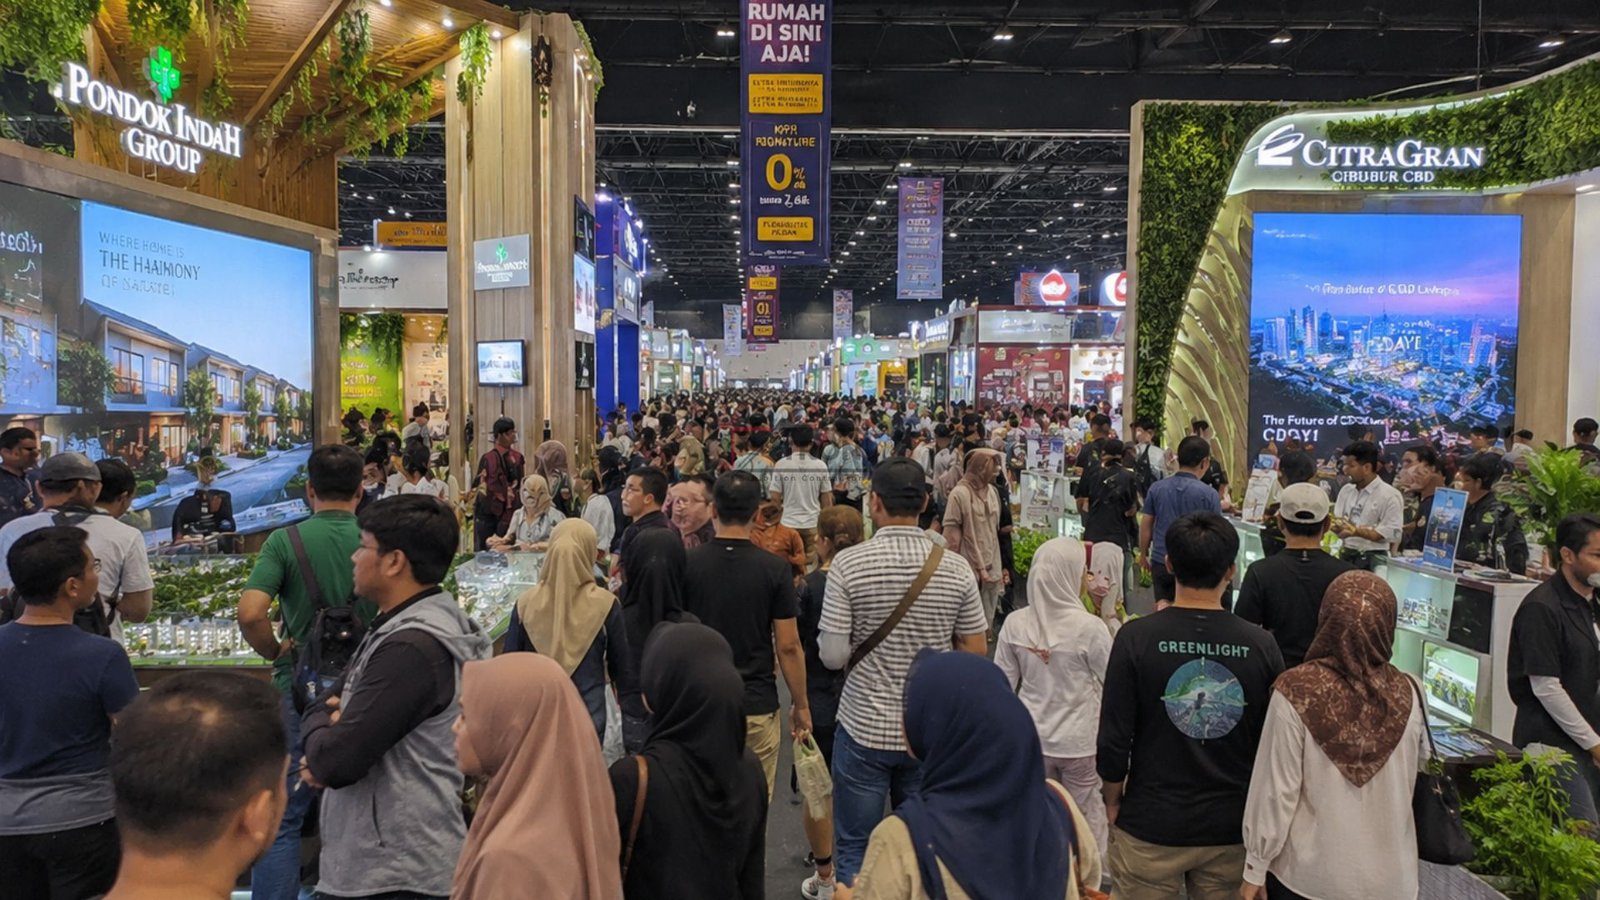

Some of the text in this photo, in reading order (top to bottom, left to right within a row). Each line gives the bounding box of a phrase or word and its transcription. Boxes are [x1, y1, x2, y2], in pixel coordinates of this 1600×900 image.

[748, 3, 825, 21] RUMAH
[751, 23, 822, 42] DI SINI
[760, 44, 810, 63] AJA!
[66, 62, 242, 159] PONDOK INDAH
[126, 127, 201, 174] GROUP
[1402, 170, 1435, 183] CBD
[99, 231, 140, 250] WHERE
[99, 249, 130, 270] THE
[1262, 414, 1285, 426] The
[1287, 414, 1325, 426] Future
[1158, 640, 1250, 658] GREENLIGHT
